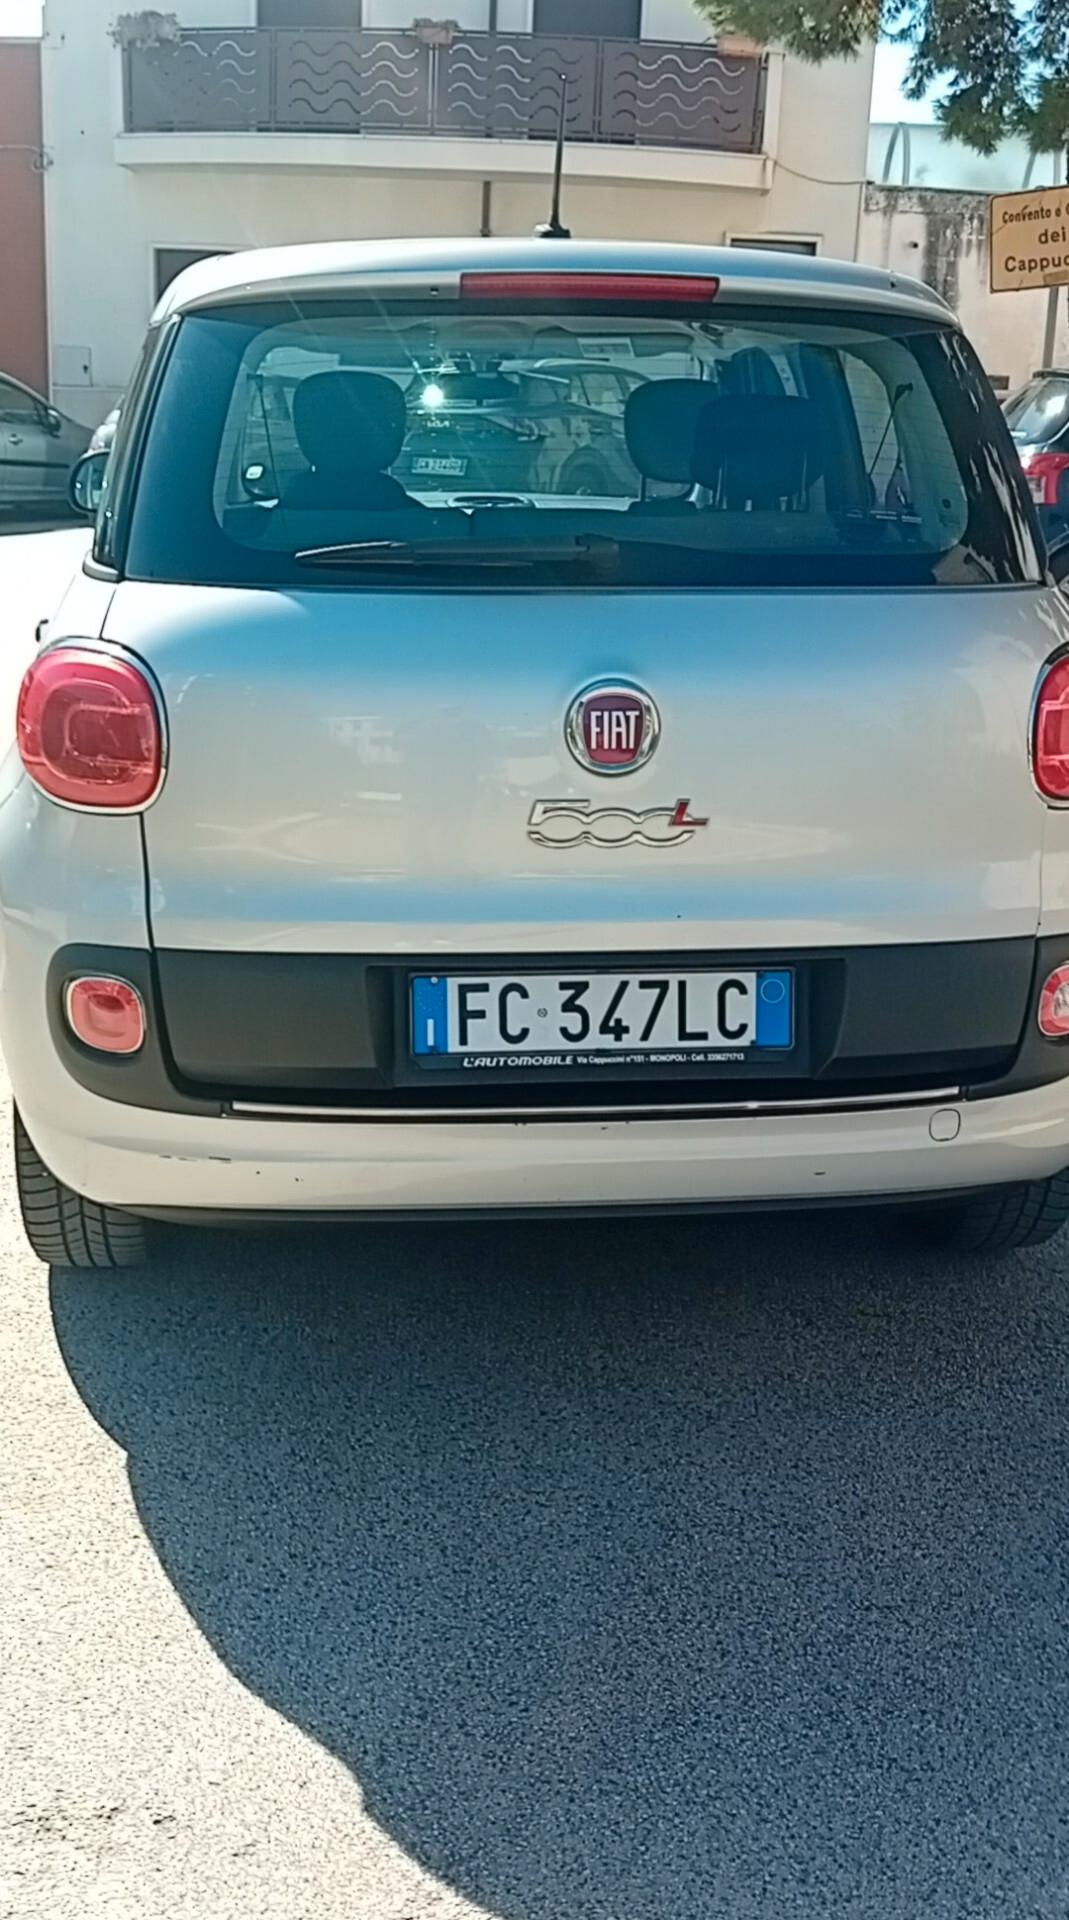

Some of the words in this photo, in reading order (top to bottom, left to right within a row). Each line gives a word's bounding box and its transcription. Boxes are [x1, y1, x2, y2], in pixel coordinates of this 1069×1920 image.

[1002, 205, 1051, 224] Convento
[1038, 226, 1066, 244] dei
[590, 711, 640, 750] FIAT
[457, 982, 531, 1046] FC
[558, 979, 749, 1043] 347LC
[463, 1056, 574, 1067] L'AUTOMOBILE
